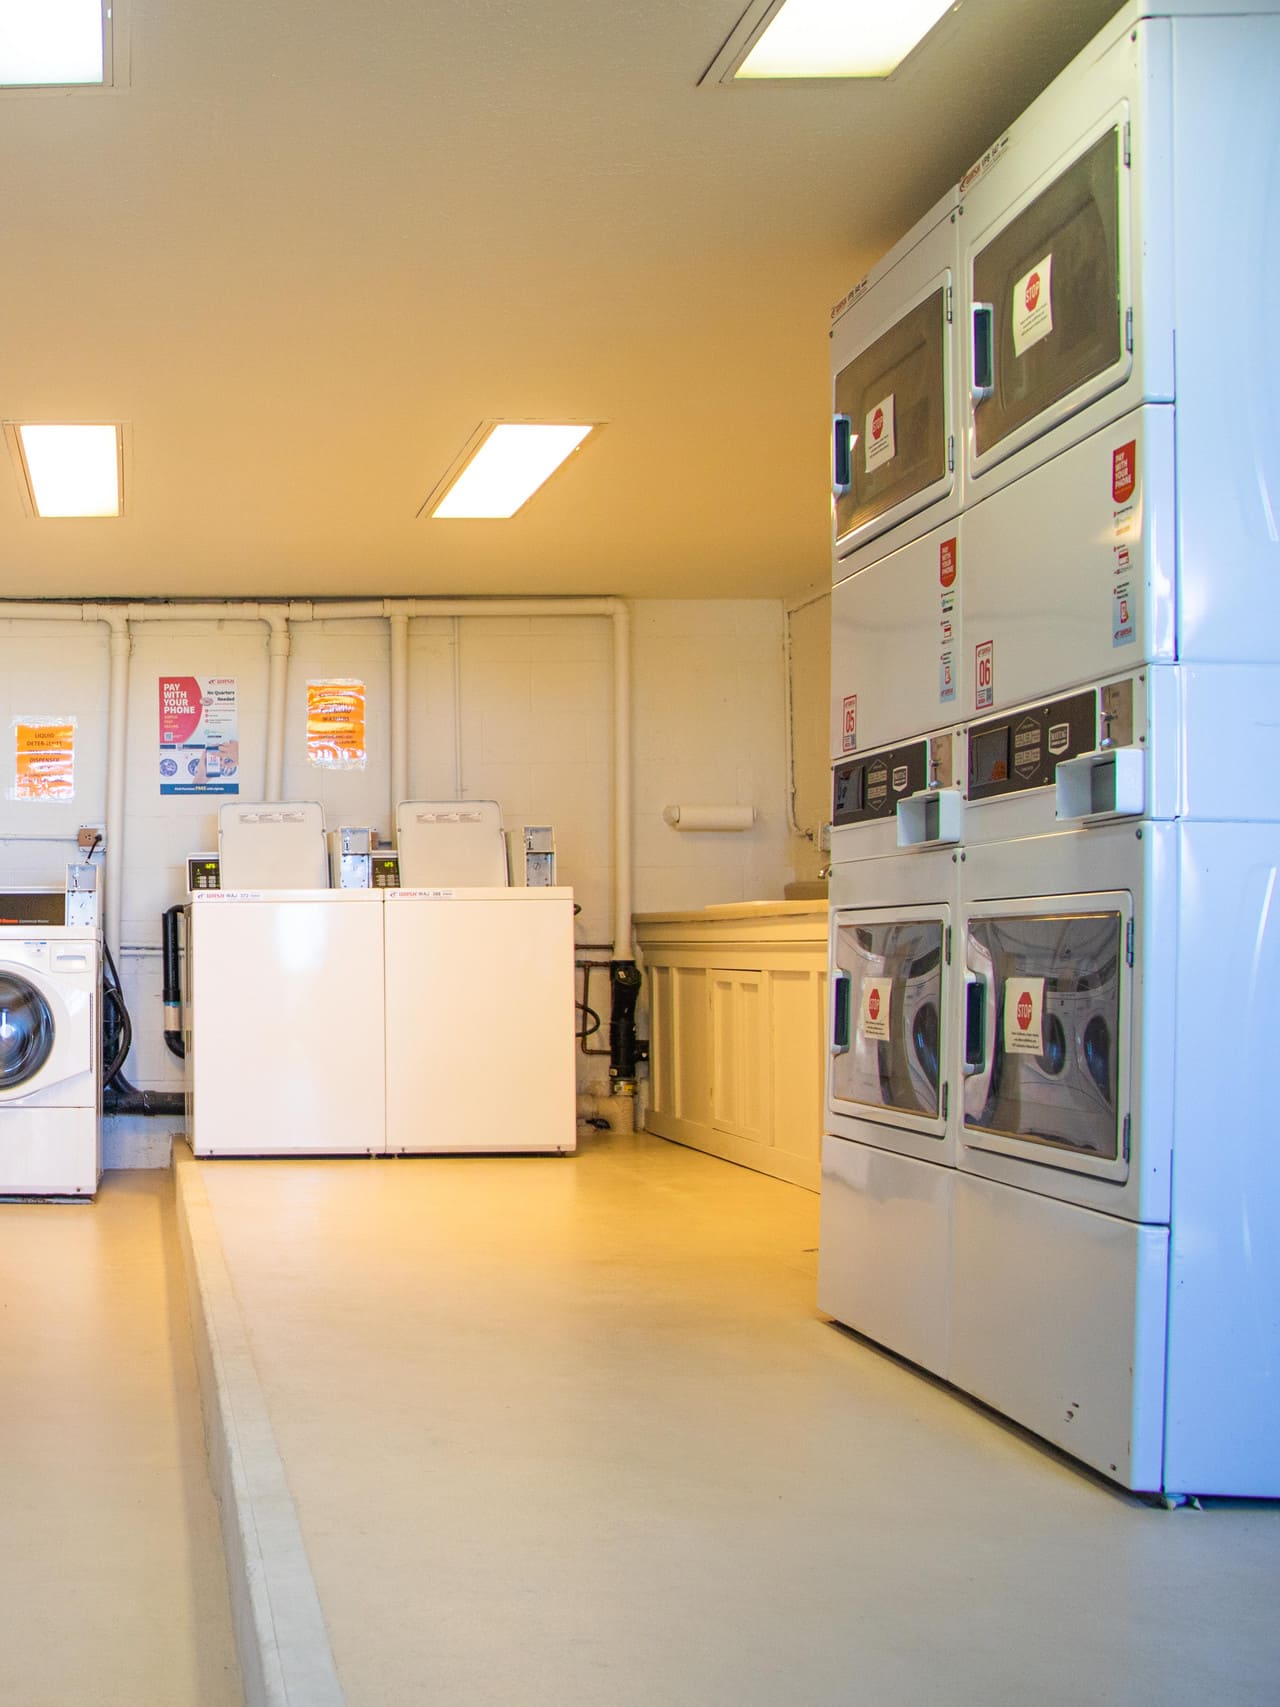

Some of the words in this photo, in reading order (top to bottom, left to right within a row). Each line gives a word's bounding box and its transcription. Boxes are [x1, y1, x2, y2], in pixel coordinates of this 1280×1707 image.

[1026, 281, 1040, 304] STOP
[1115, 460, 1128, 472] WITH
[1115, 468, 1128, 480] YOUR
[1116, 474, 1132, 488] PHONE
[980, 658, 990, 687] 06
[164, 683, 180, 691] PAY
[846, 710, 854, 733] 05
[869, 998, 880, 1009] STOP
[1017, 1004, 1032, 1018] STOP
